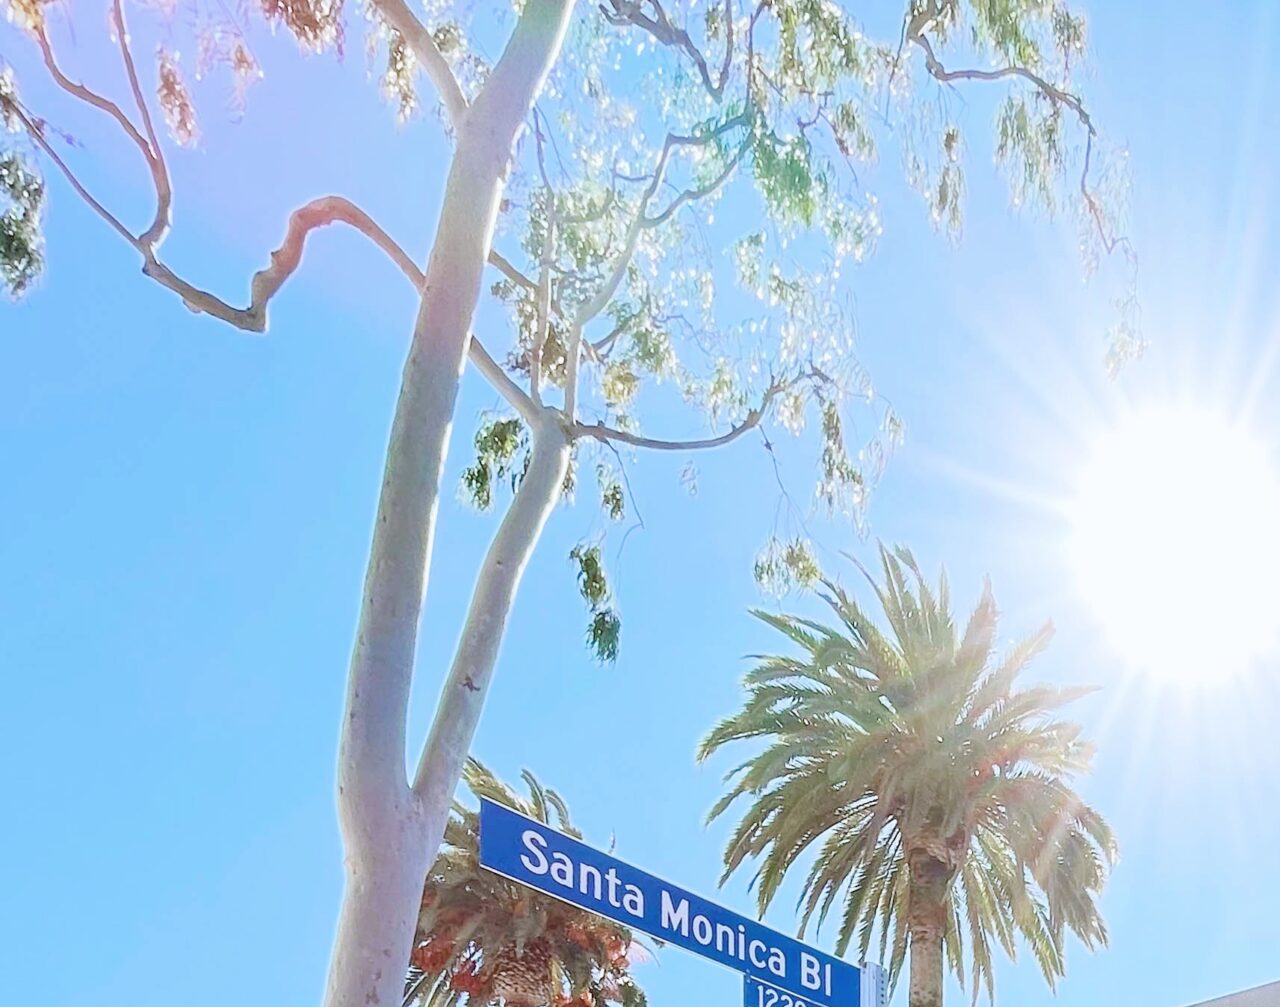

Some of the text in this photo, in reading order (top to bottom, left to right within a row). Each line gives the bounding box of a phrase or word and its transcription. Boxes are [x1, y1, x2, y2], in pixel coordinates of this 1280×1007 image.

[520, 830, 832, 997] Santa Monica Bl
